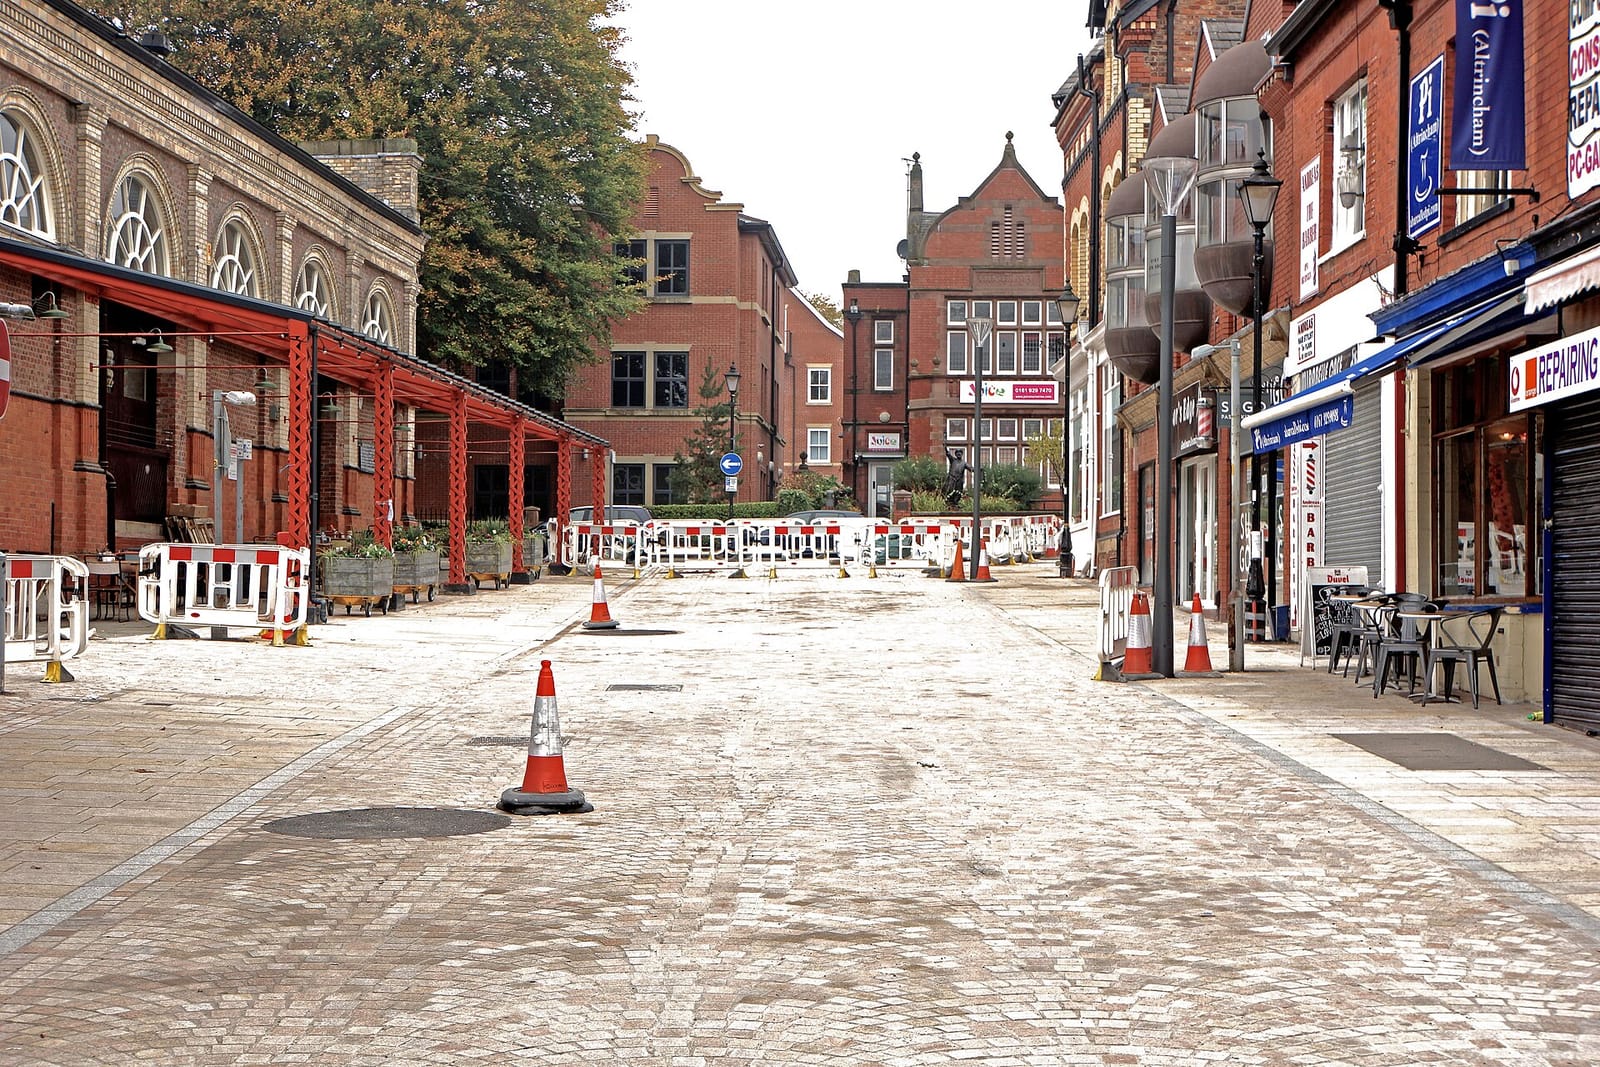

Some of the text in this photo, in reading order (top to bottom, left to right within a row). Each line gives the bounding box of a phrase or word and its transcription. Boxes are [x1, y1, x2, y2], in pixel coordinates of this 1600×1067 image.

[1570, 35, 1600, 81] CONS
[1418, 73, 1432, 125] Pi
[1468, 29, 1491, 156] (Altrincham)
[1570, 141, 1600, 183] PC-GA
[1538, 337, 1599, 395] REPAIRING
[1327, 575, 1350, 583] Duvel
